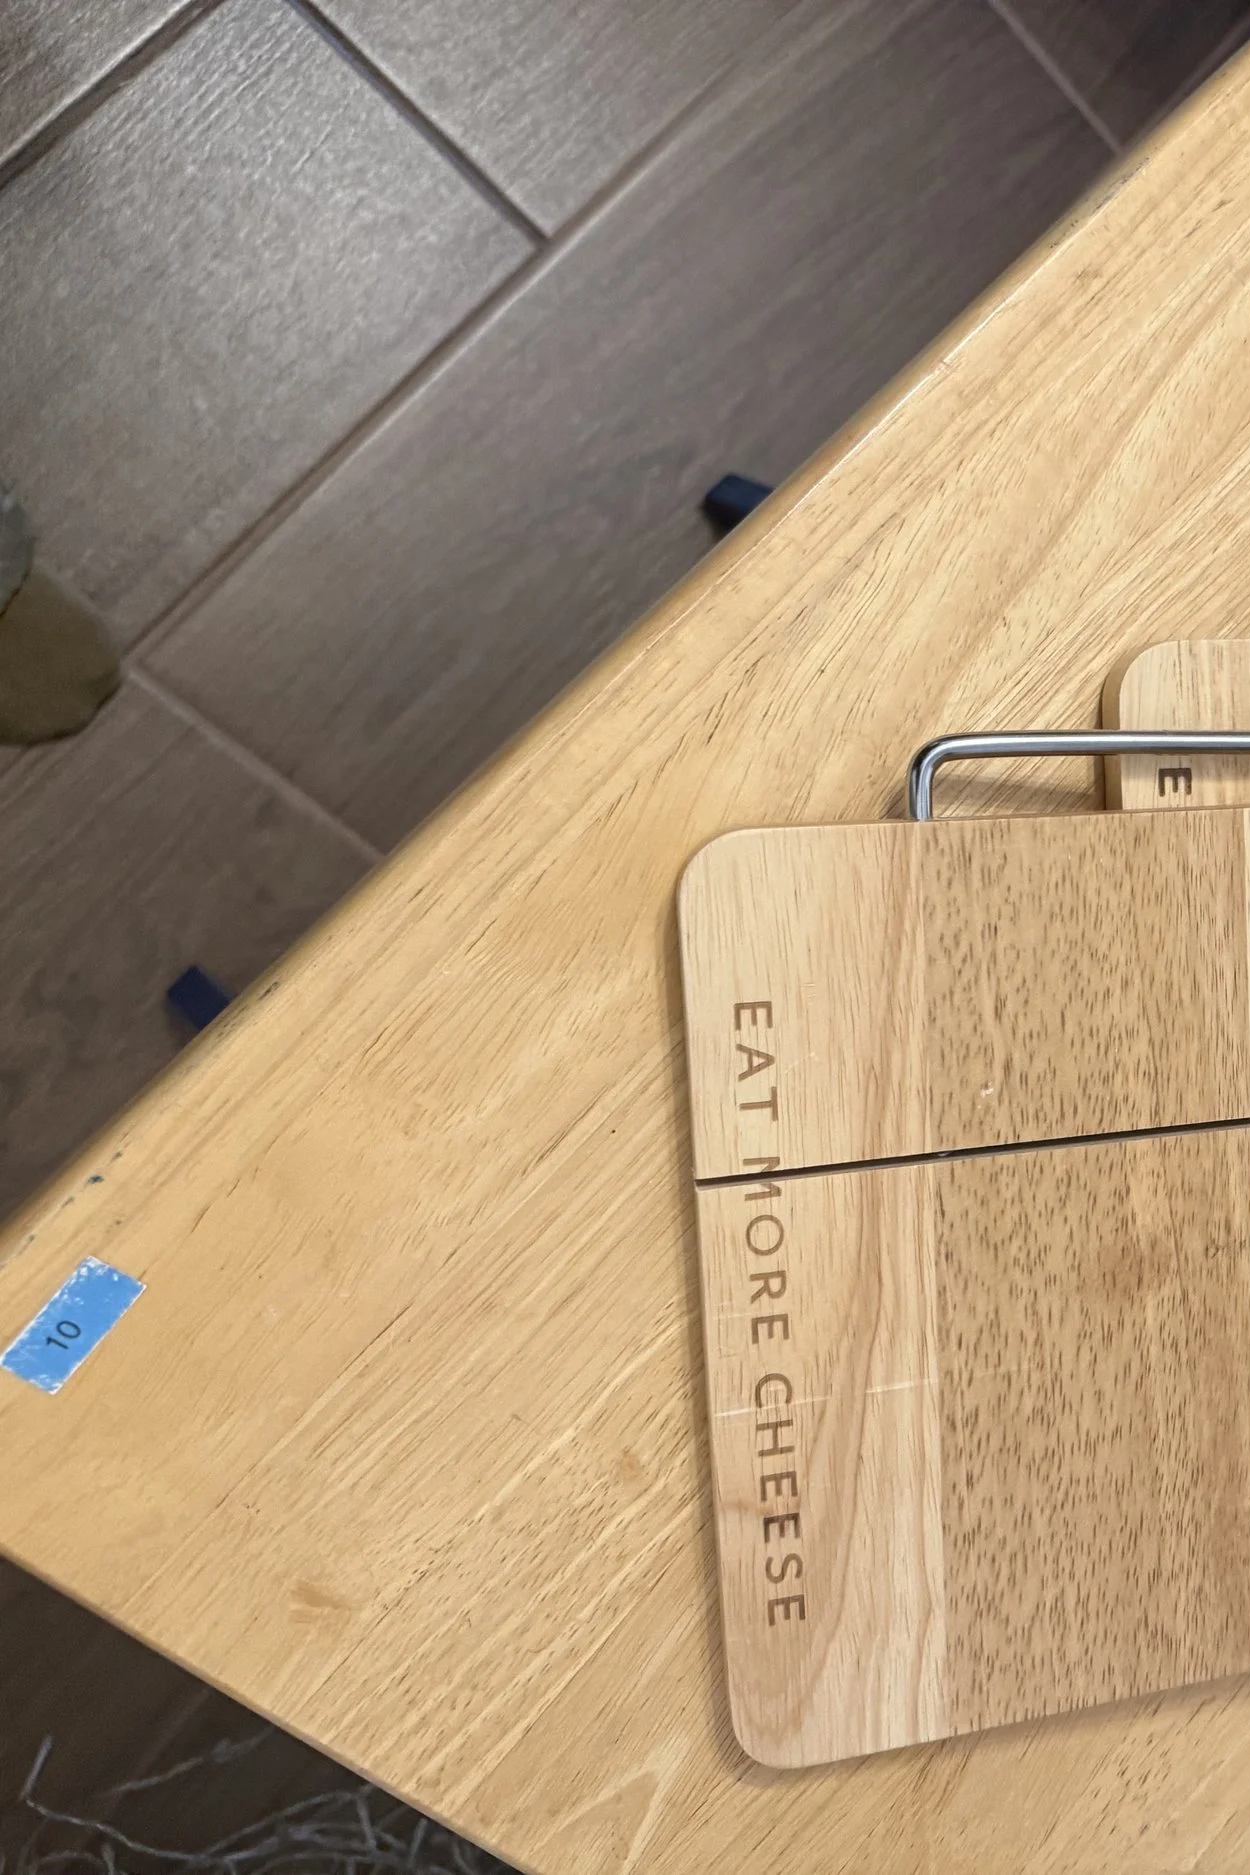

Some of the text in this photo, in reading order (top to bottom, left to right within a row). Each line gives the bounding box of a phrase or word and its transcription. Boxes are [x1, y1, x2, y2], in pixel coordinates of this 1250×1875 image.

[46, 1320, 81, 1350] 10
[734, 1001, 806, 1627] EAT MORE CHEESE
